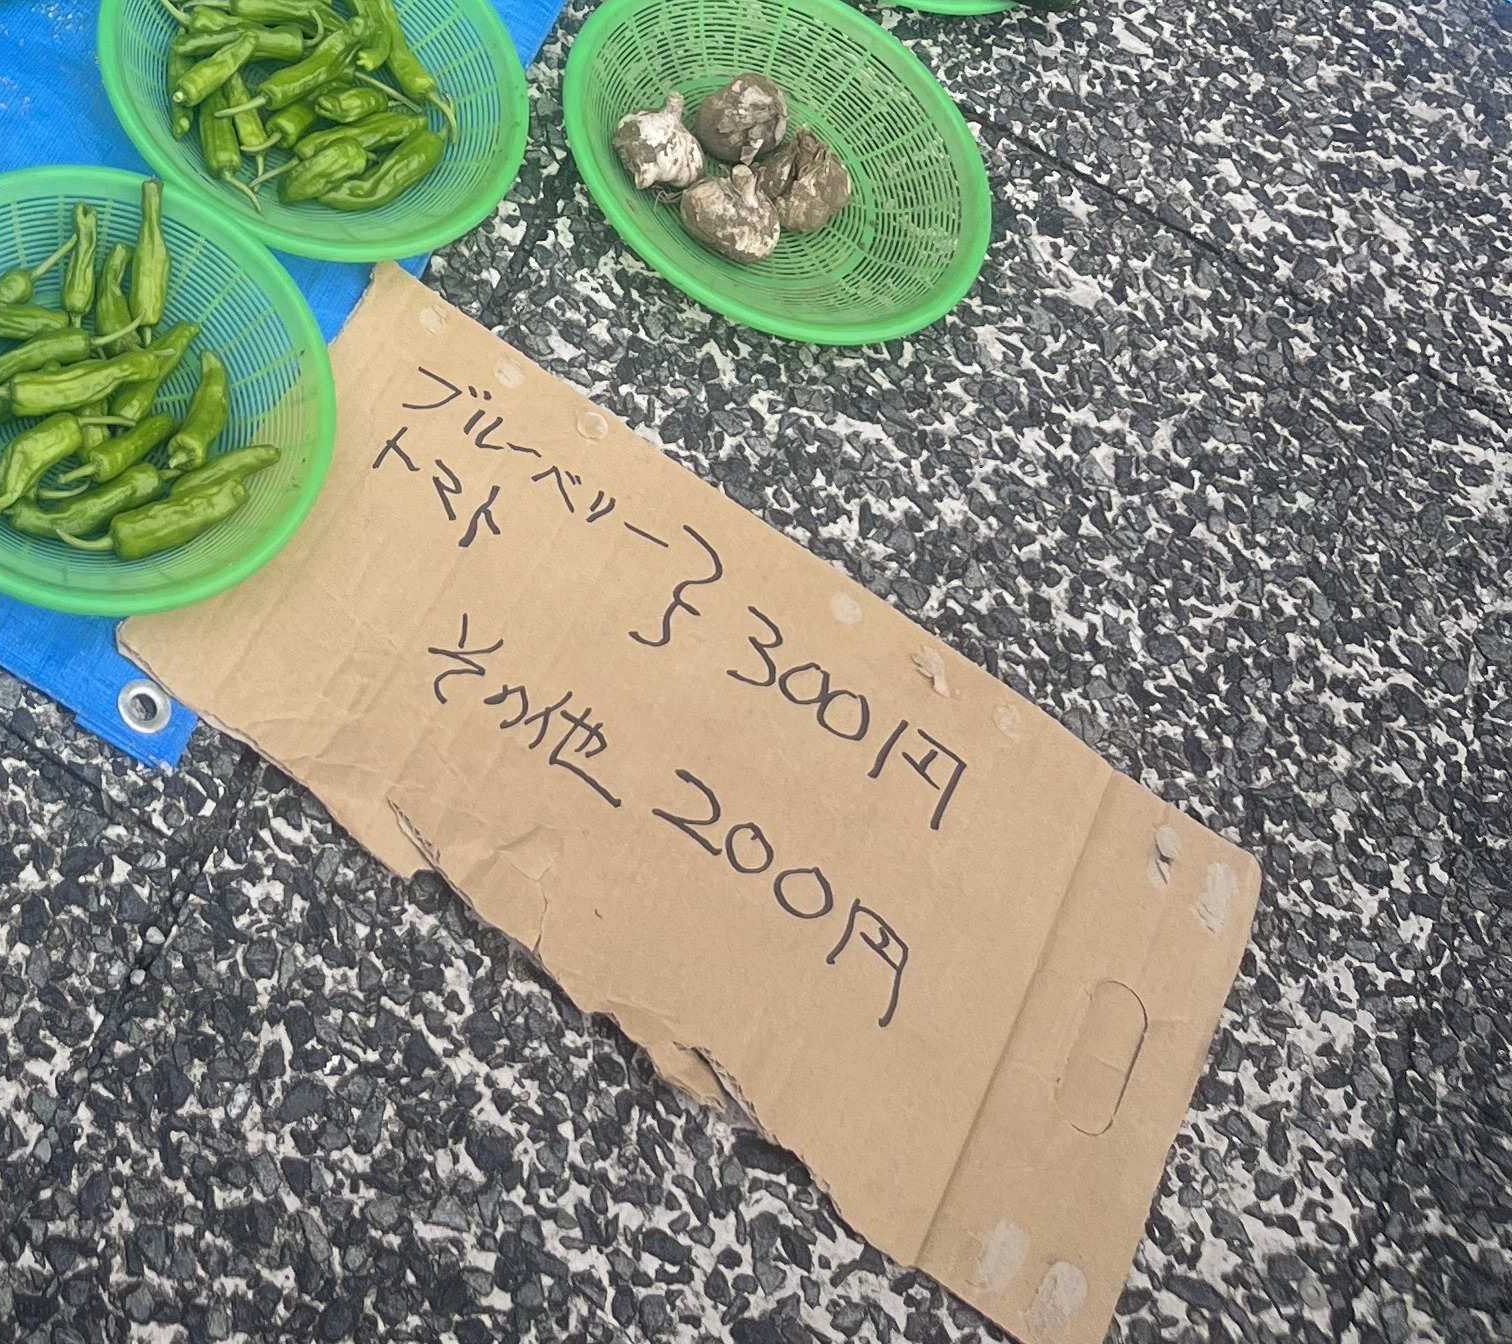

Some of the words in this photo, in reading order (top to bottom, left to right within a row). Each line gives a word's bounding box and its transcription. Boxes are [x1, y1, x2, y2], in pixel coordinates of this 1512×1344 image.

[372, 427, 501, 548] トマト
[402, 366, 669, 548] ブルーベリー
[726, 606, 967, 830] 300円
[428, 614, 622, 808] その他
[651, 769, 909, 1028] 200円
